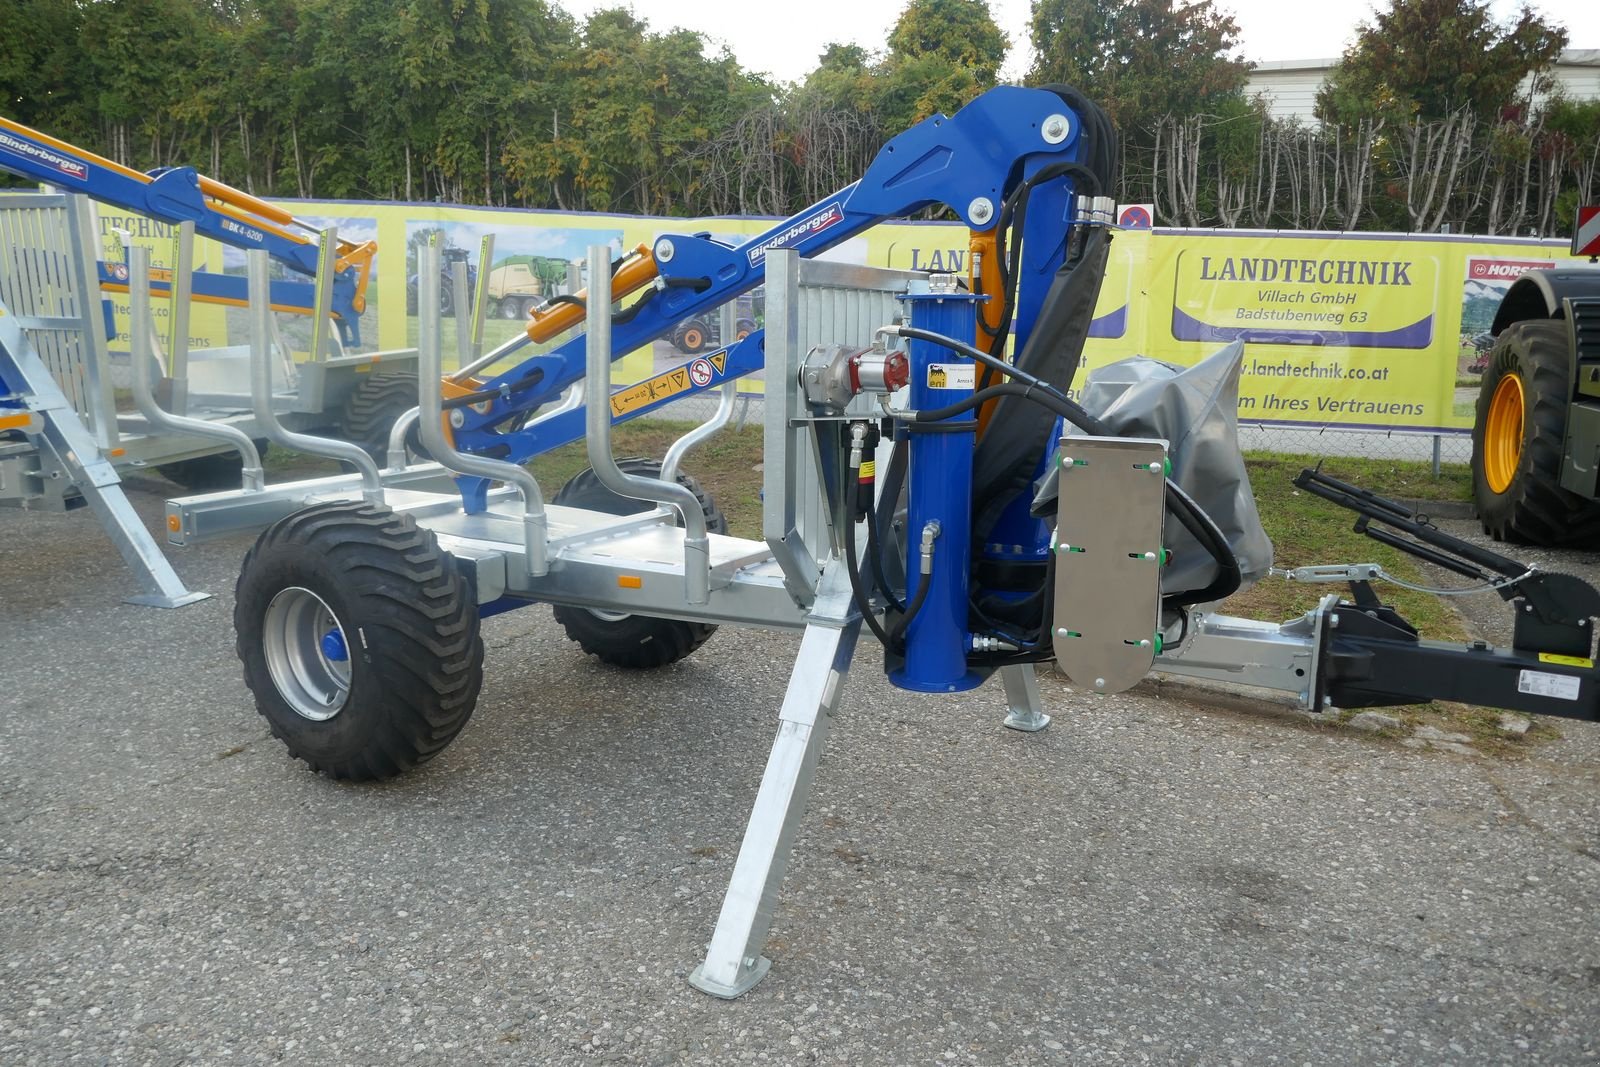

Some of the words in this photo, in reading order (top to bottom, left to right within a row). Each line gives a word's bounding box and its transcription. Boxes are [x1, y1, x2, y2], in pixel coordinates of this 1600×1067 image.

[0, 135, 83, 170] Binderberger
[1200, 257, 1412, 285] LANDTECHNIK
[1258, 290, 1304, 303] Villach
[1310, 293, 1356, 304] GmbH
[1236, 308, 1344, 324] Badstubenweg
[1349, 312, 1367, 322] 63
[930, 379, 944, 388] eni
[1263, 394, 1309, 411] Ihres
[1317, 397, 1424, 416] Vertrauens
